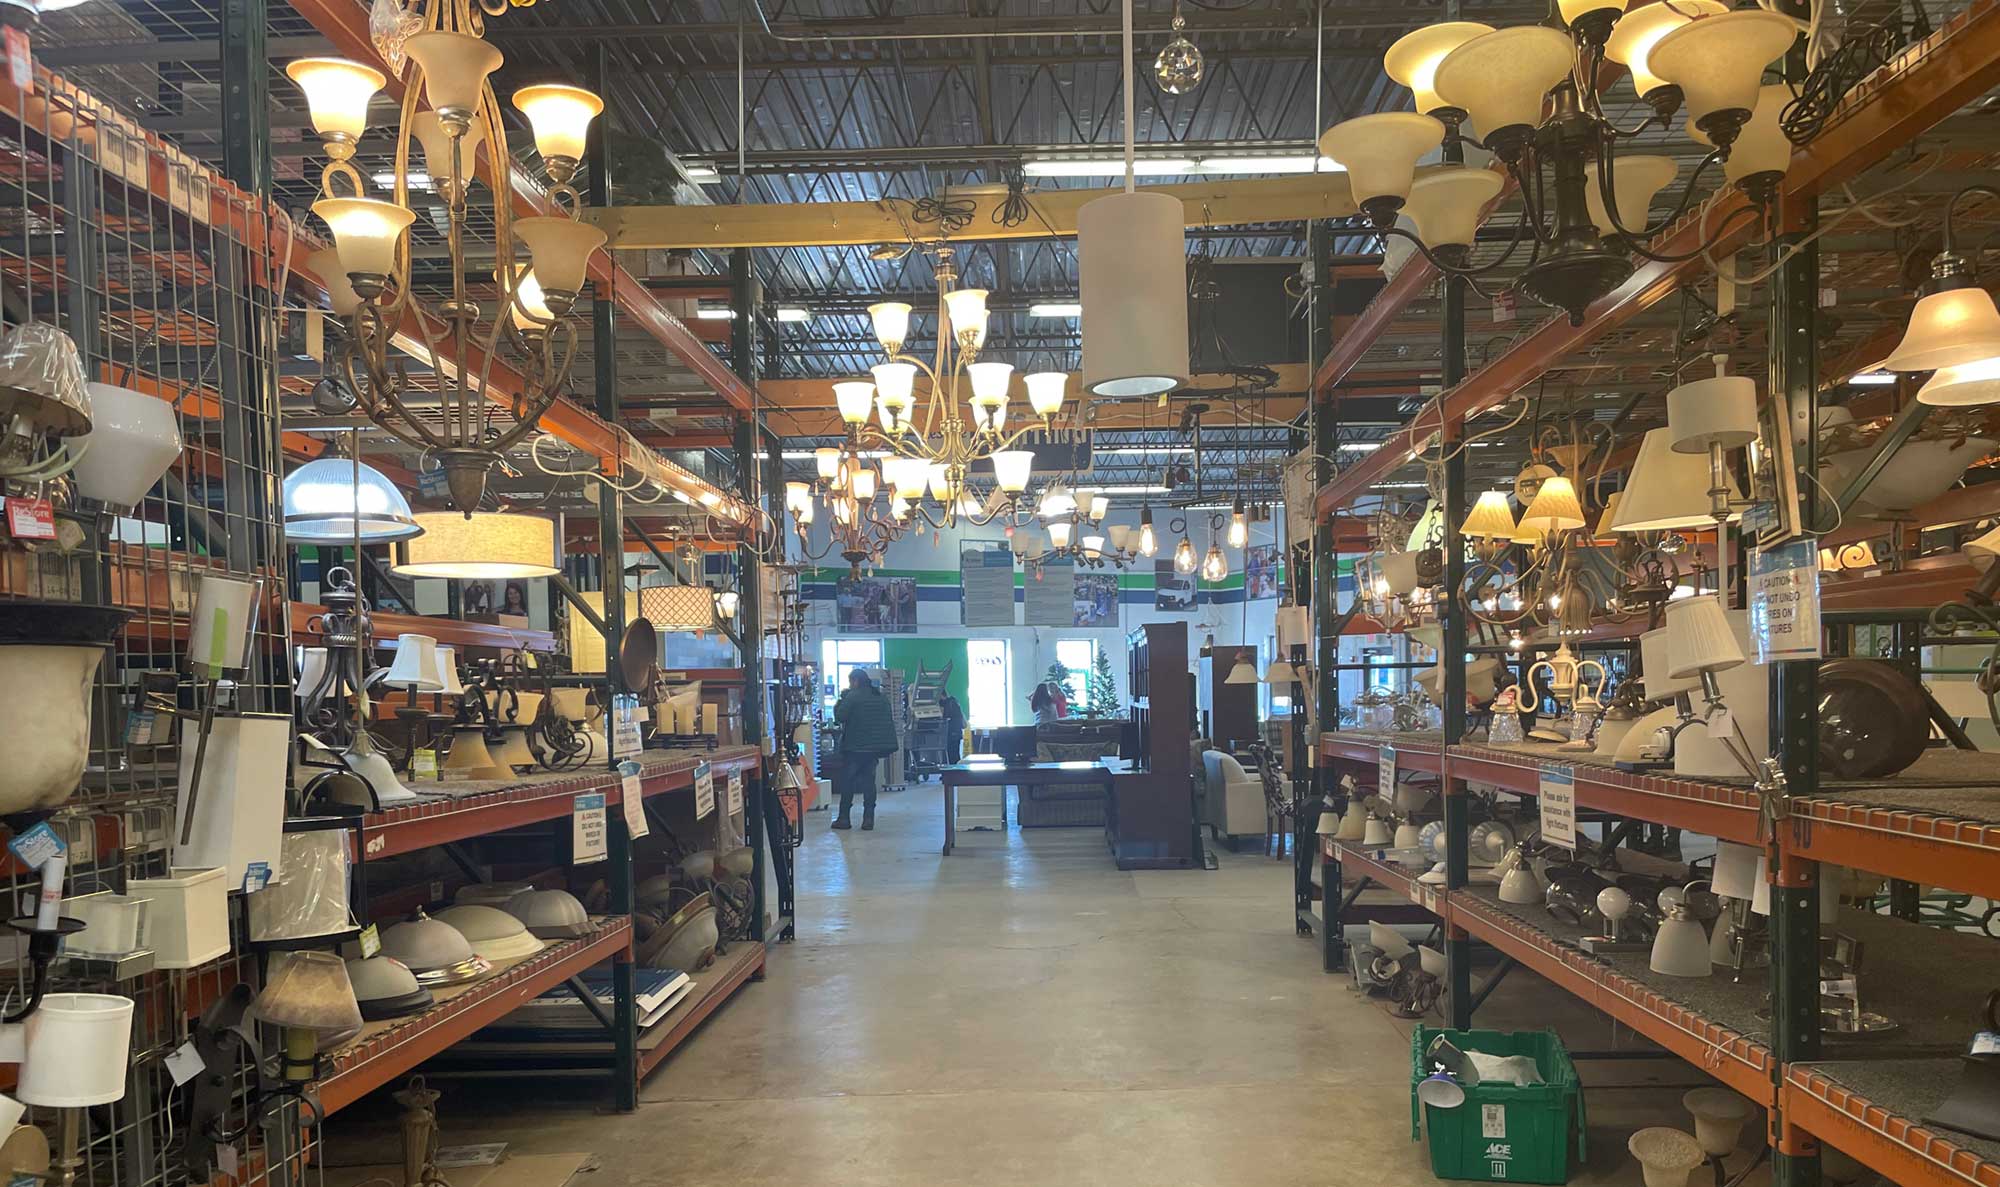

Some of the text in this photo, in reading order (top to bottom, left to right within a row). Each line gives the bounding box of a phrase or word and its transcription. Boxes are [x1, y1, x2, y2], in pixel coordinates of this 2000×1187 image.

[1764, 576, 1790, 588] CAUTION
[1782, 607, 1792, 618] ON
[1486, 1143, 1512, 1154] ACE
